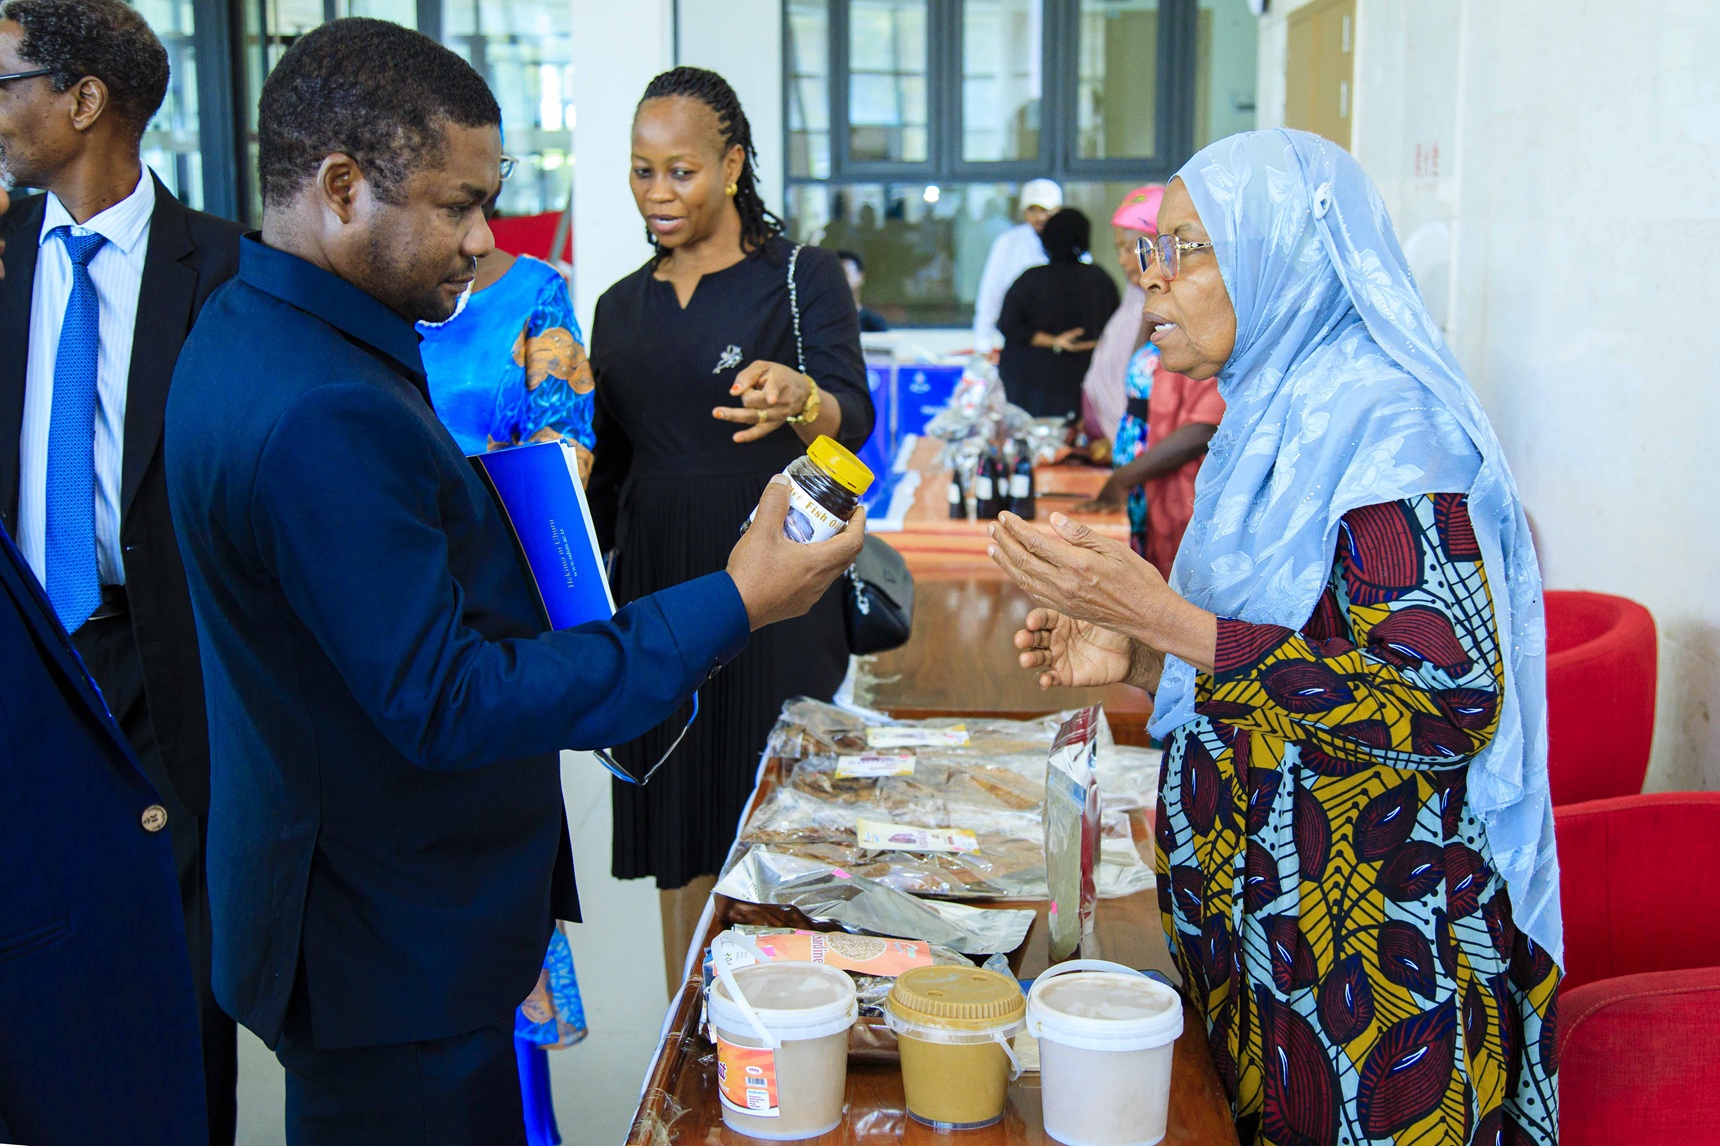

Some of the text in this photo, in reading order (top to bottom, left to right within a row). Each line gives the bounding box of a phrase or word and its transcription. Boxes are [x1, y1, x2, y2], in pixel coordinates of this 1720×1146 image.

[806, 501, 827, 522] Fish
[829, 519, 842, 531] Oil
[550, 520, 560, 545] Uhuru
[561, 556, 574, 588] Hekima
